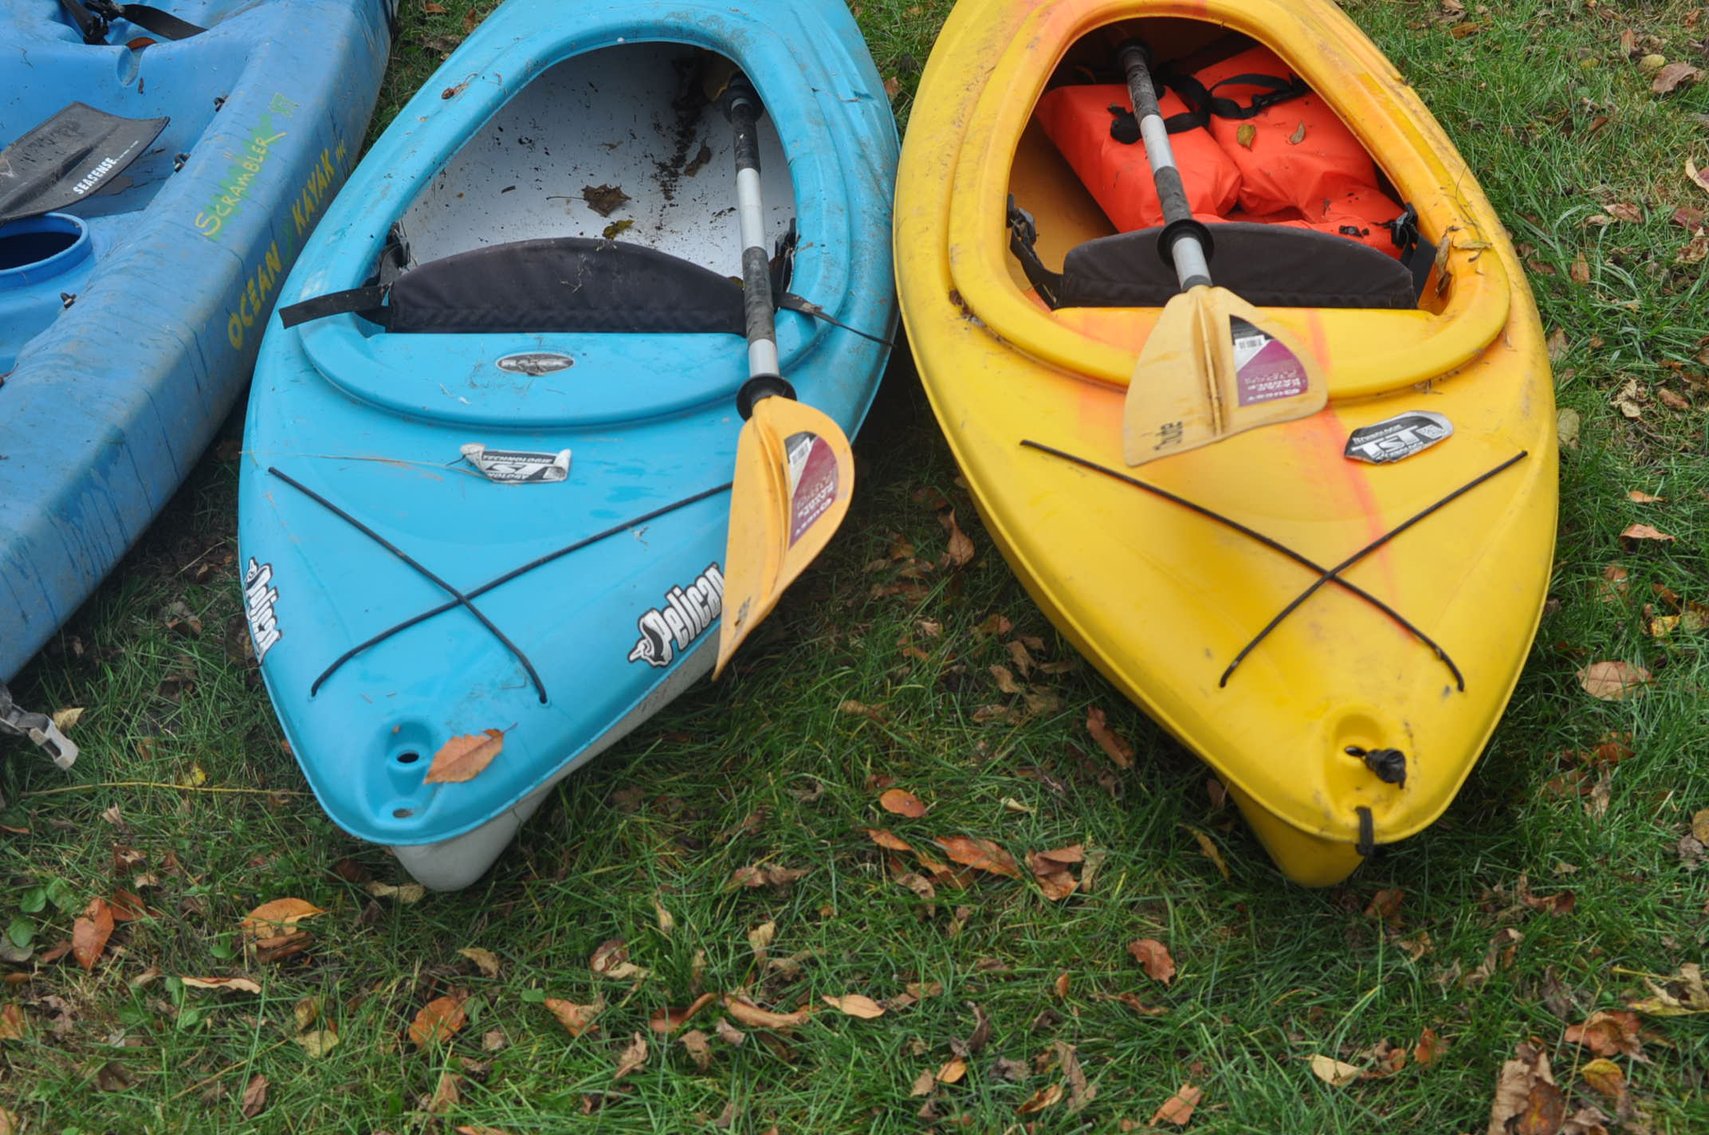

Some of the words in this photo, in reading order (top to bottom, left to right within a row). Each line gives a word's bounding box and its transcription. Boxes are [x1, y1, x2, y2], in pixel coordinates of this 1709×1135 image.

[73, 157, 117, 194] SEASENSE
[228, 240, 282, 351] OCEAN
[291, 147, 335, 236] KAYAK
